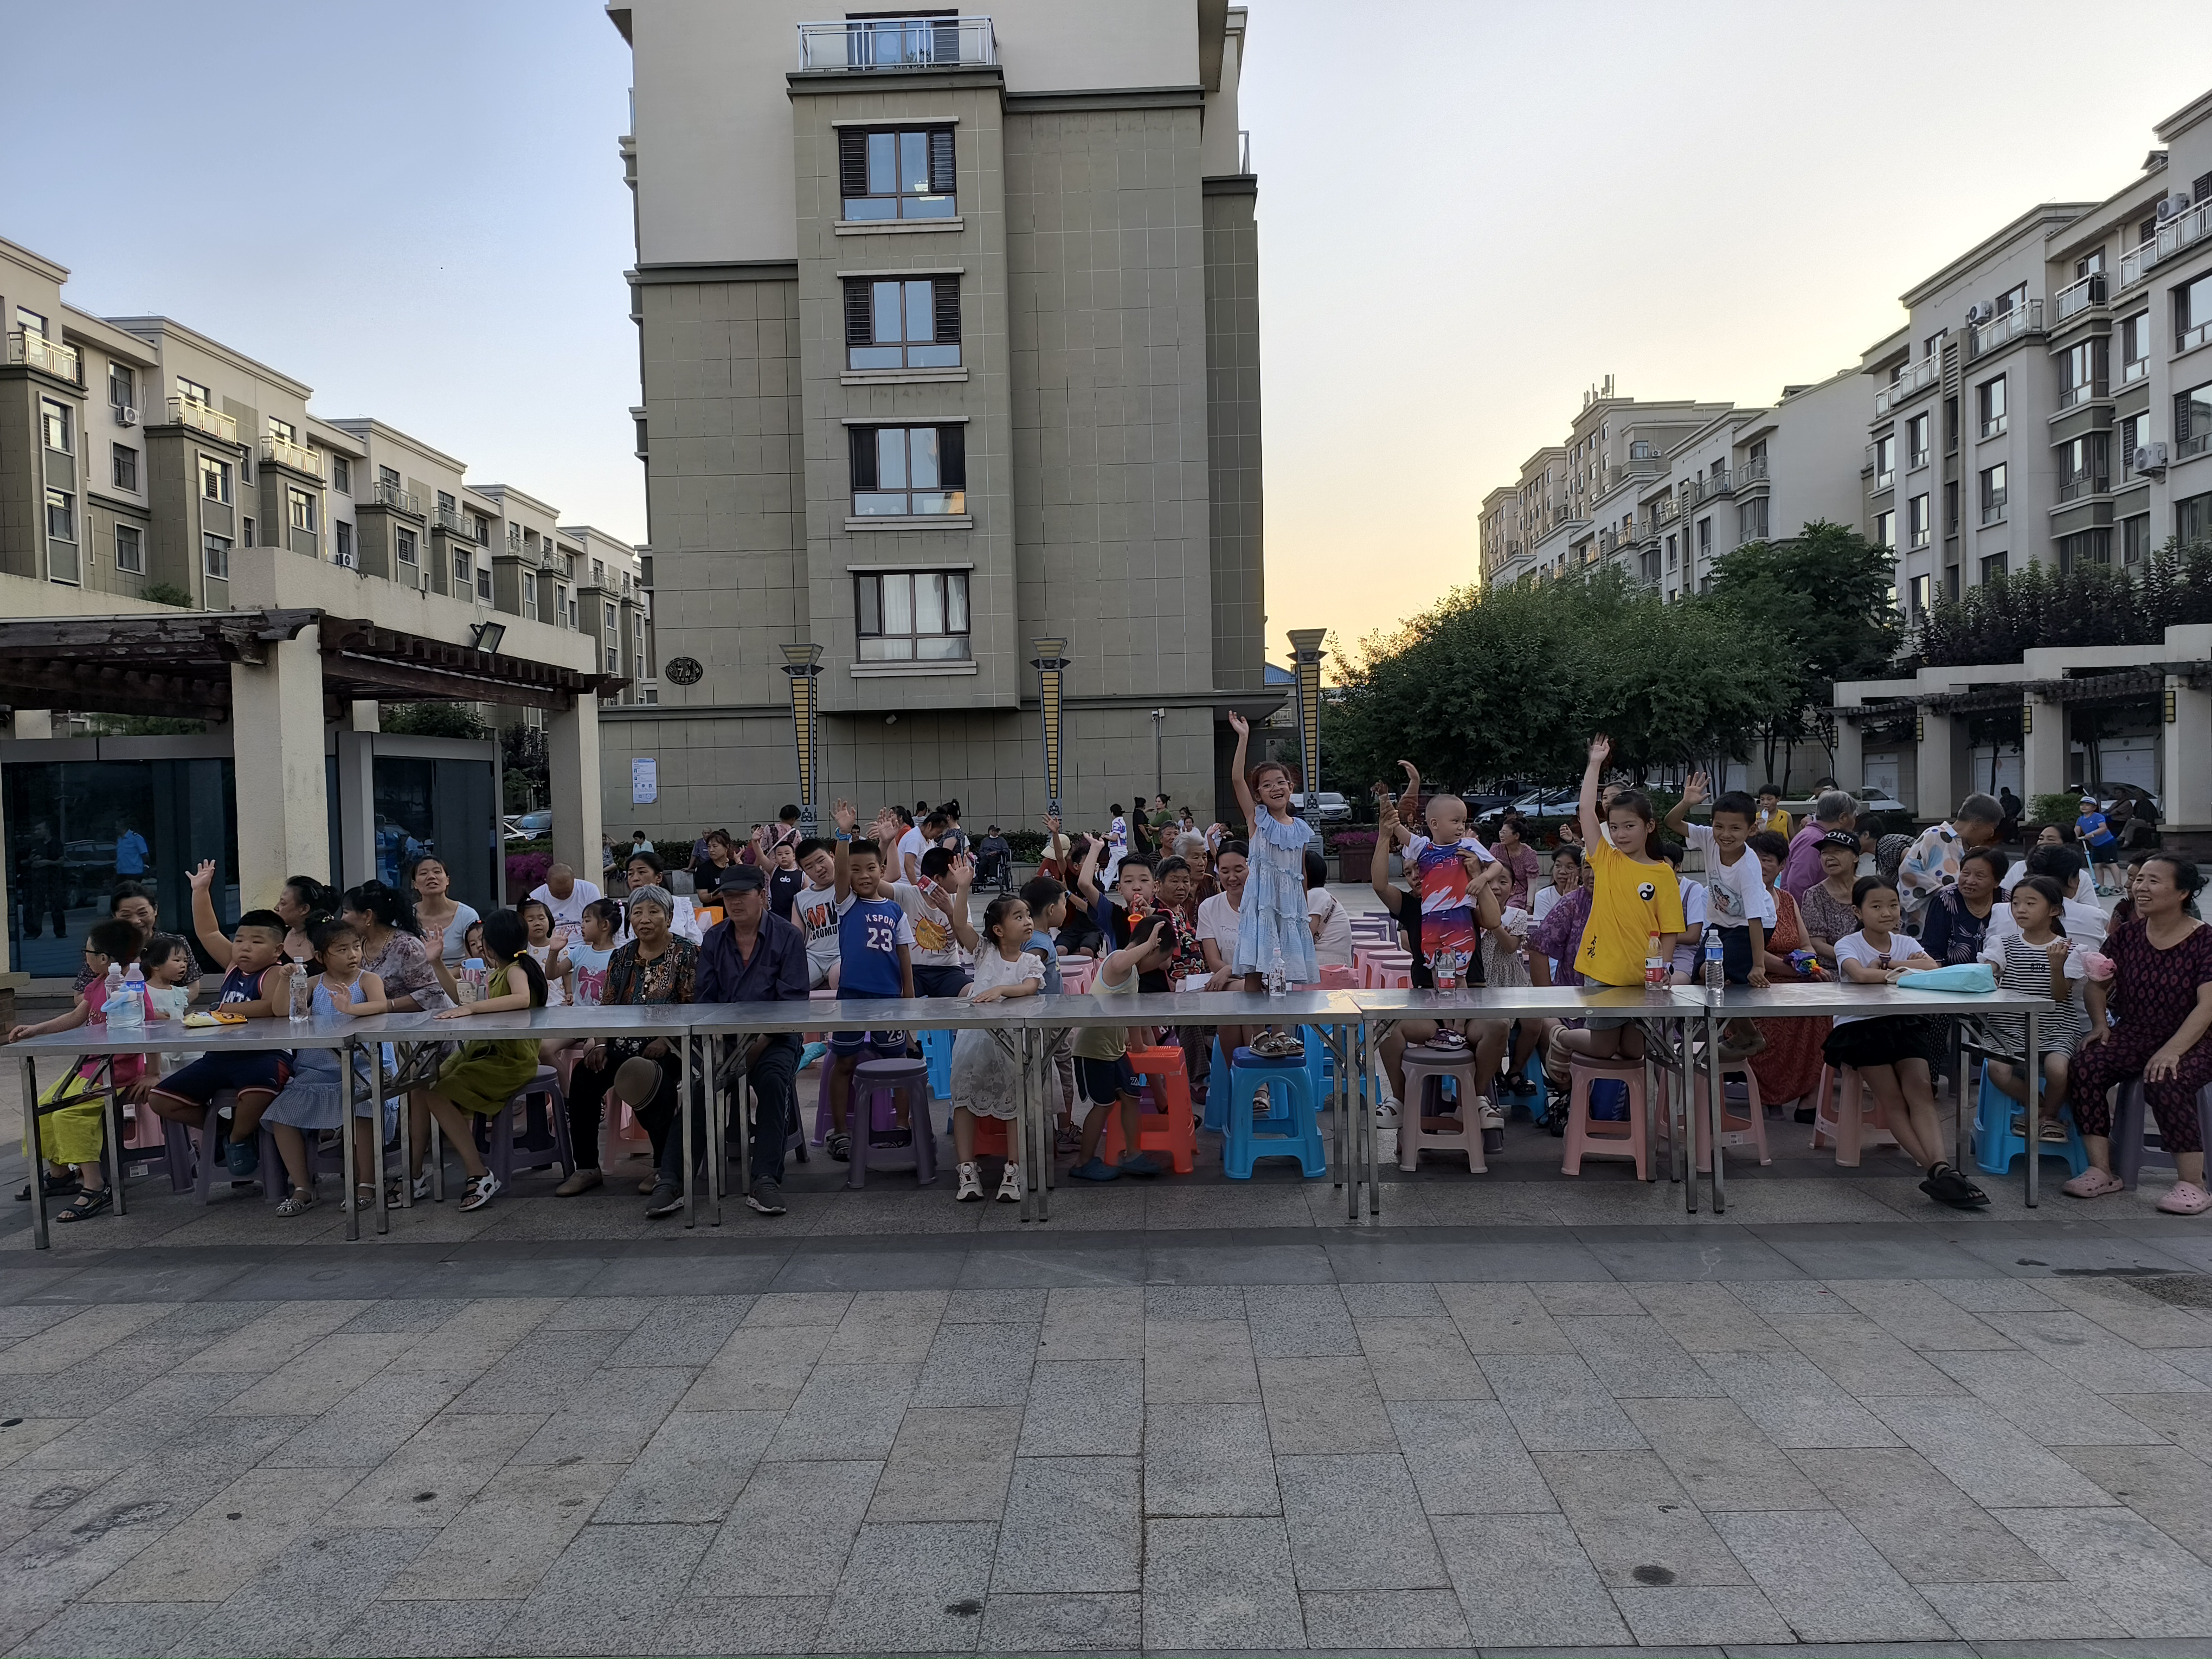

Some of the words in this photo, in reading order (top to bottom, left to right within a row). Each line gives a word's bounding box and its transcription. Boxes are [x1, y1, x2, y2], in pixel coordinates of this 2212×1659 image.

[1822, 831, 1854, 844] ORT
[866, 927, 893, 953] 23
[887, 1030, 903, 1042] 23
